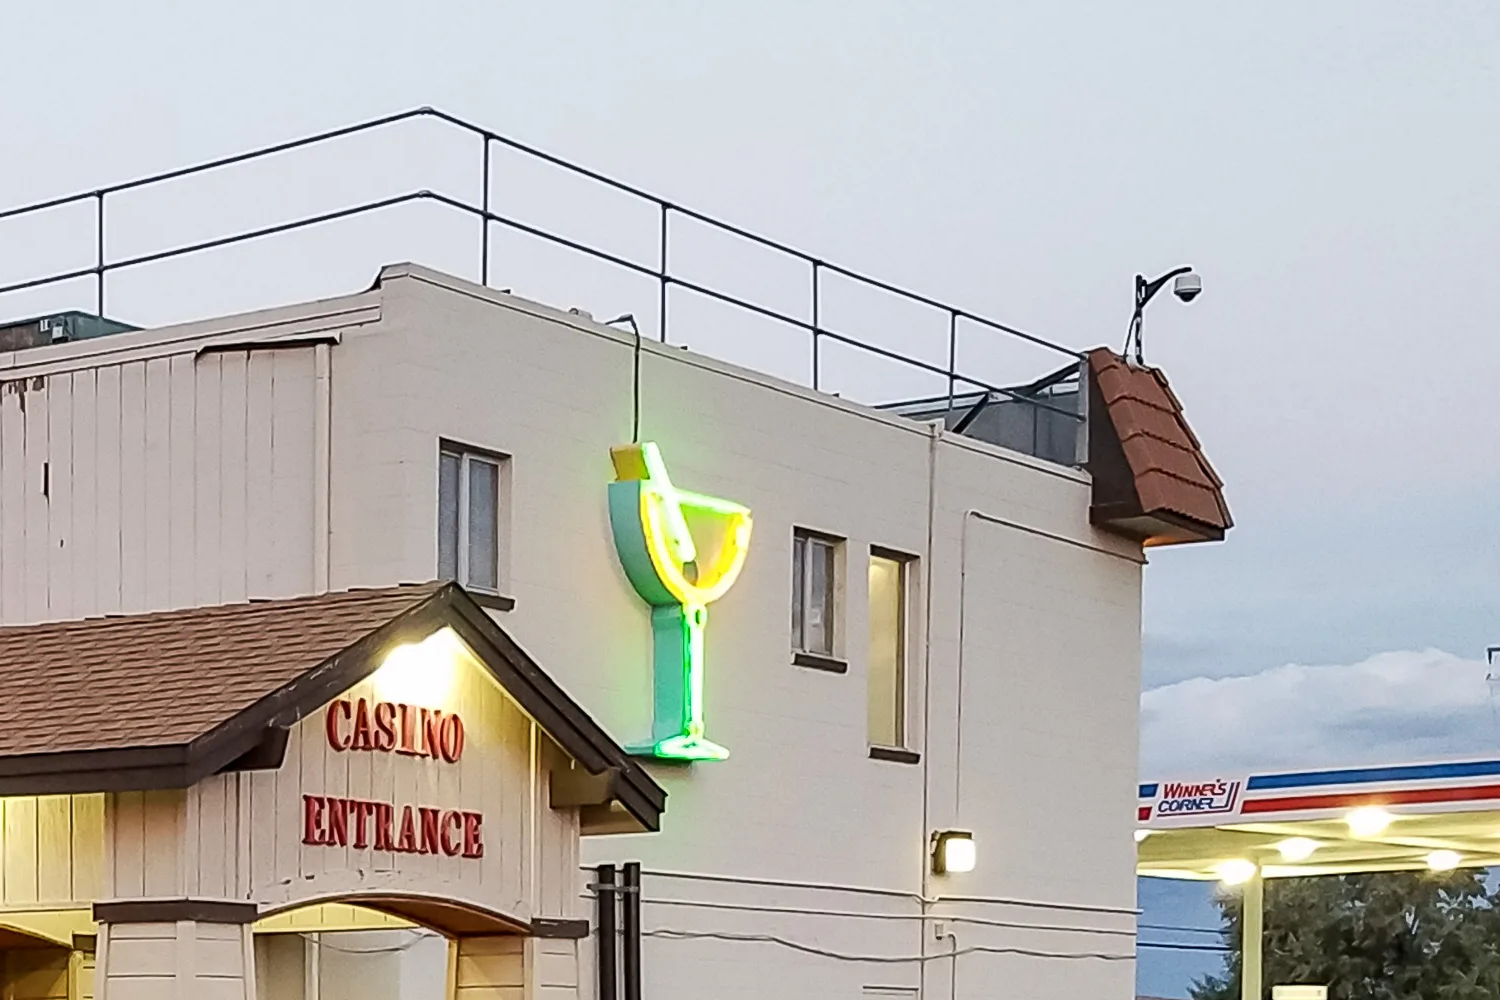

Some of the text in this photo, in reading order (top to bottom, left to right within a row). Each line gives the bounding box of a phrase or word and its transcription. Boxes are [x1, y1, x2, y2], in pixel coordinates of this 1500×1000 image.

[326, 697, 464, 764] CASINO
[301, 794, 484, 858] ENTRANCE
[1158, 798, 1214, 812] CORNER
